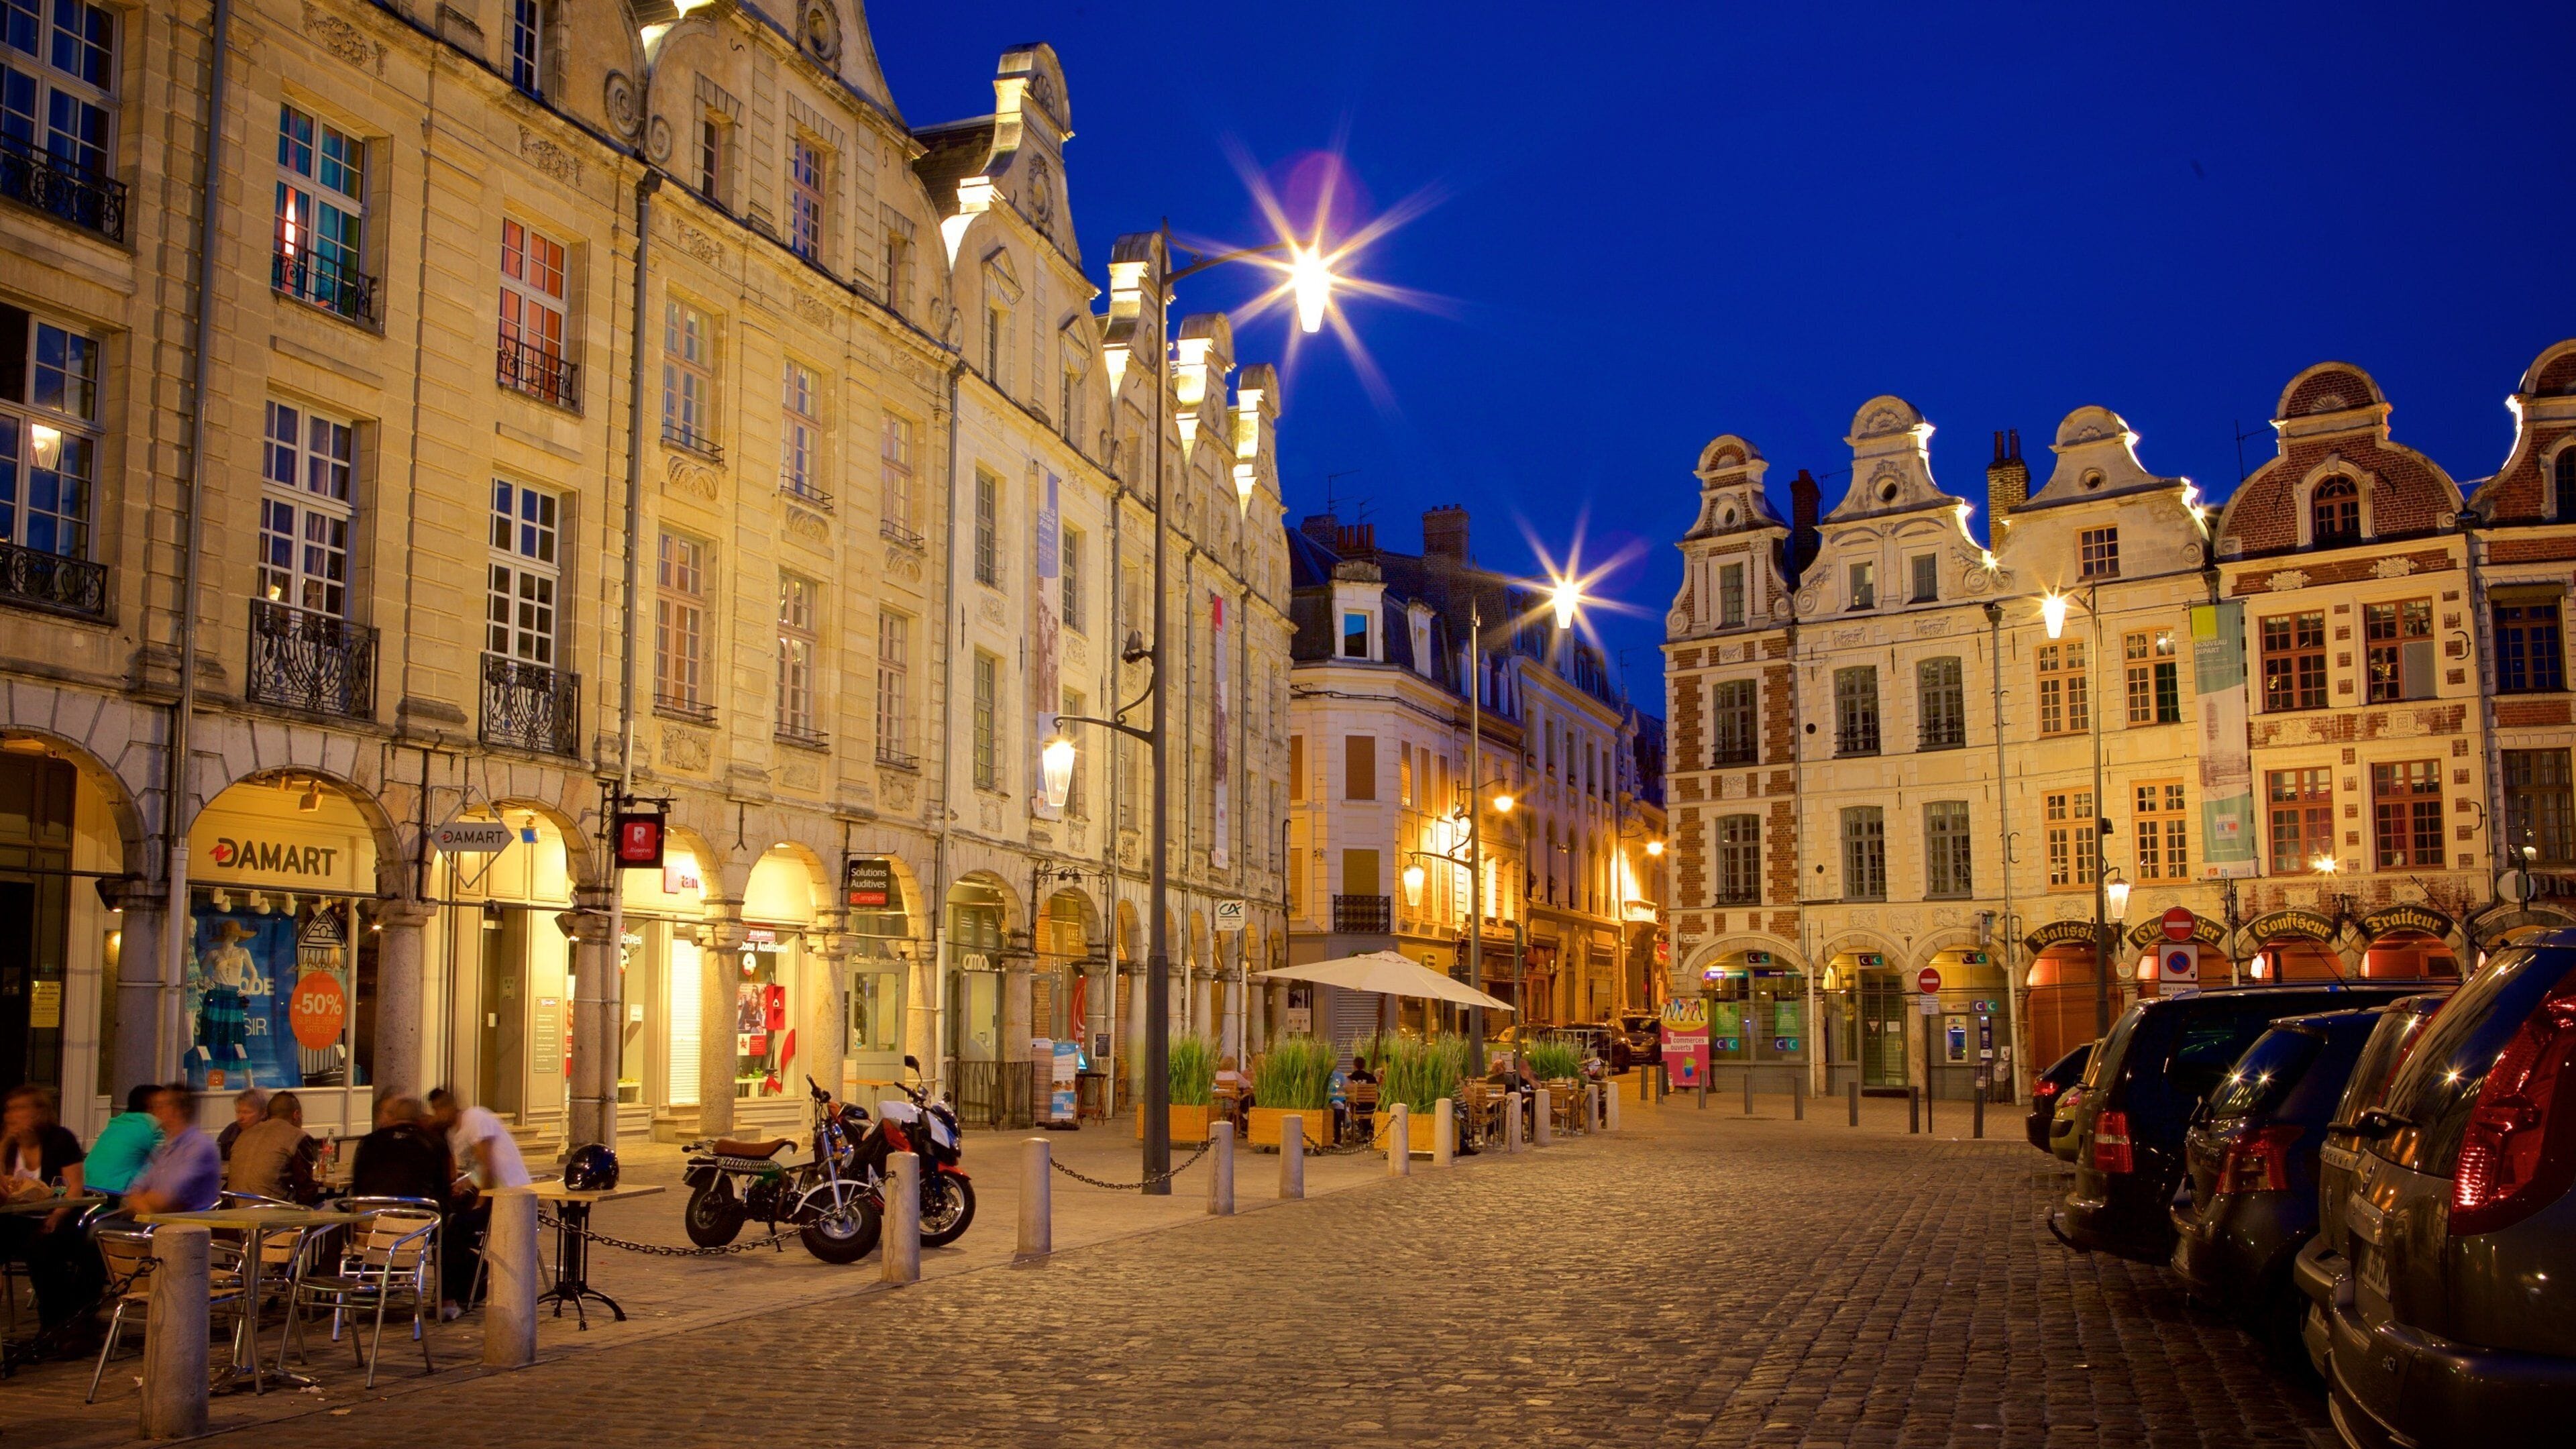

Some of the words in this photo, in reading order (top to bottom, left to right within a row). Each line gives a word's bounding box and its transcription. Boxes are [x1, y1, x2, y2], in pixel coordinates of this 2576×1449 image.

[2195, 639, 2227, 648] NOUVEAU
[441, 831, 504, 843] DAMART
[218, 838, 337, 876] DAMART
[851, 867, 887, 877] Solutions
[851, 879, 887, 888] Auditives
[2255, 912, 2332, 938] Confiseur
[2365, 908, 2443, 934] Traiteur
[2033, 922, 2097, 946] Patissi
[757, 941, 788, 953] Auditives
[239, 977, 275, 996] ODE
[295, 993, 342, 1015] -50%
